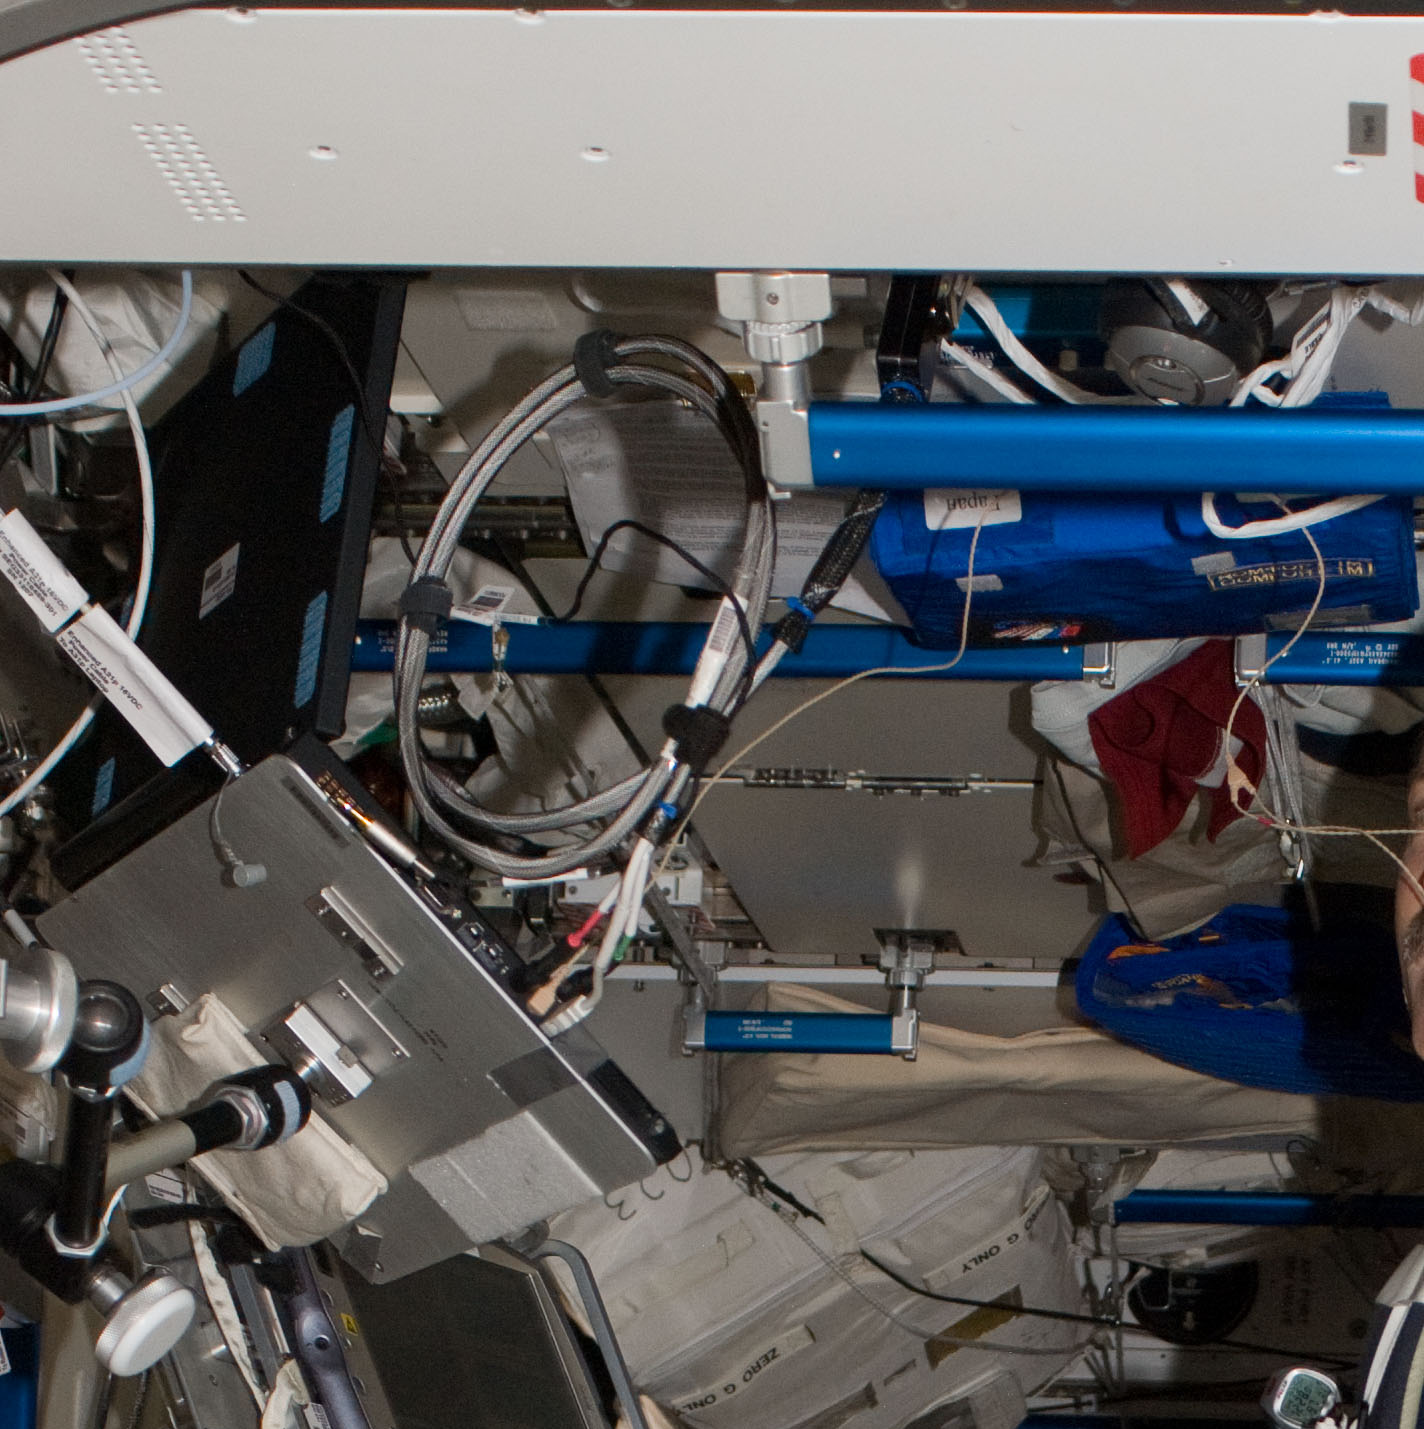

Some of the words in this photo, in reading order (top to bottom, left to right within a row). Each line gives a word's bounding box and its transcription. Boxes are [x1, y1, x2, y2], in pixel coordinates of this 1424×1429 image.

[66, 629, 102, 667] Enhanced
[67, 640, 91, 664] Power
[89, 663, 110, 685] Cable
[961, 1245, 1001, 1274] ONLY
[1007, 1233, 1019, 1245] G
[673, 1393, 717, 1417] ONLY
[723, 1383, 737, 1395] G
[741, 1346, 781, 1384] ZERO
